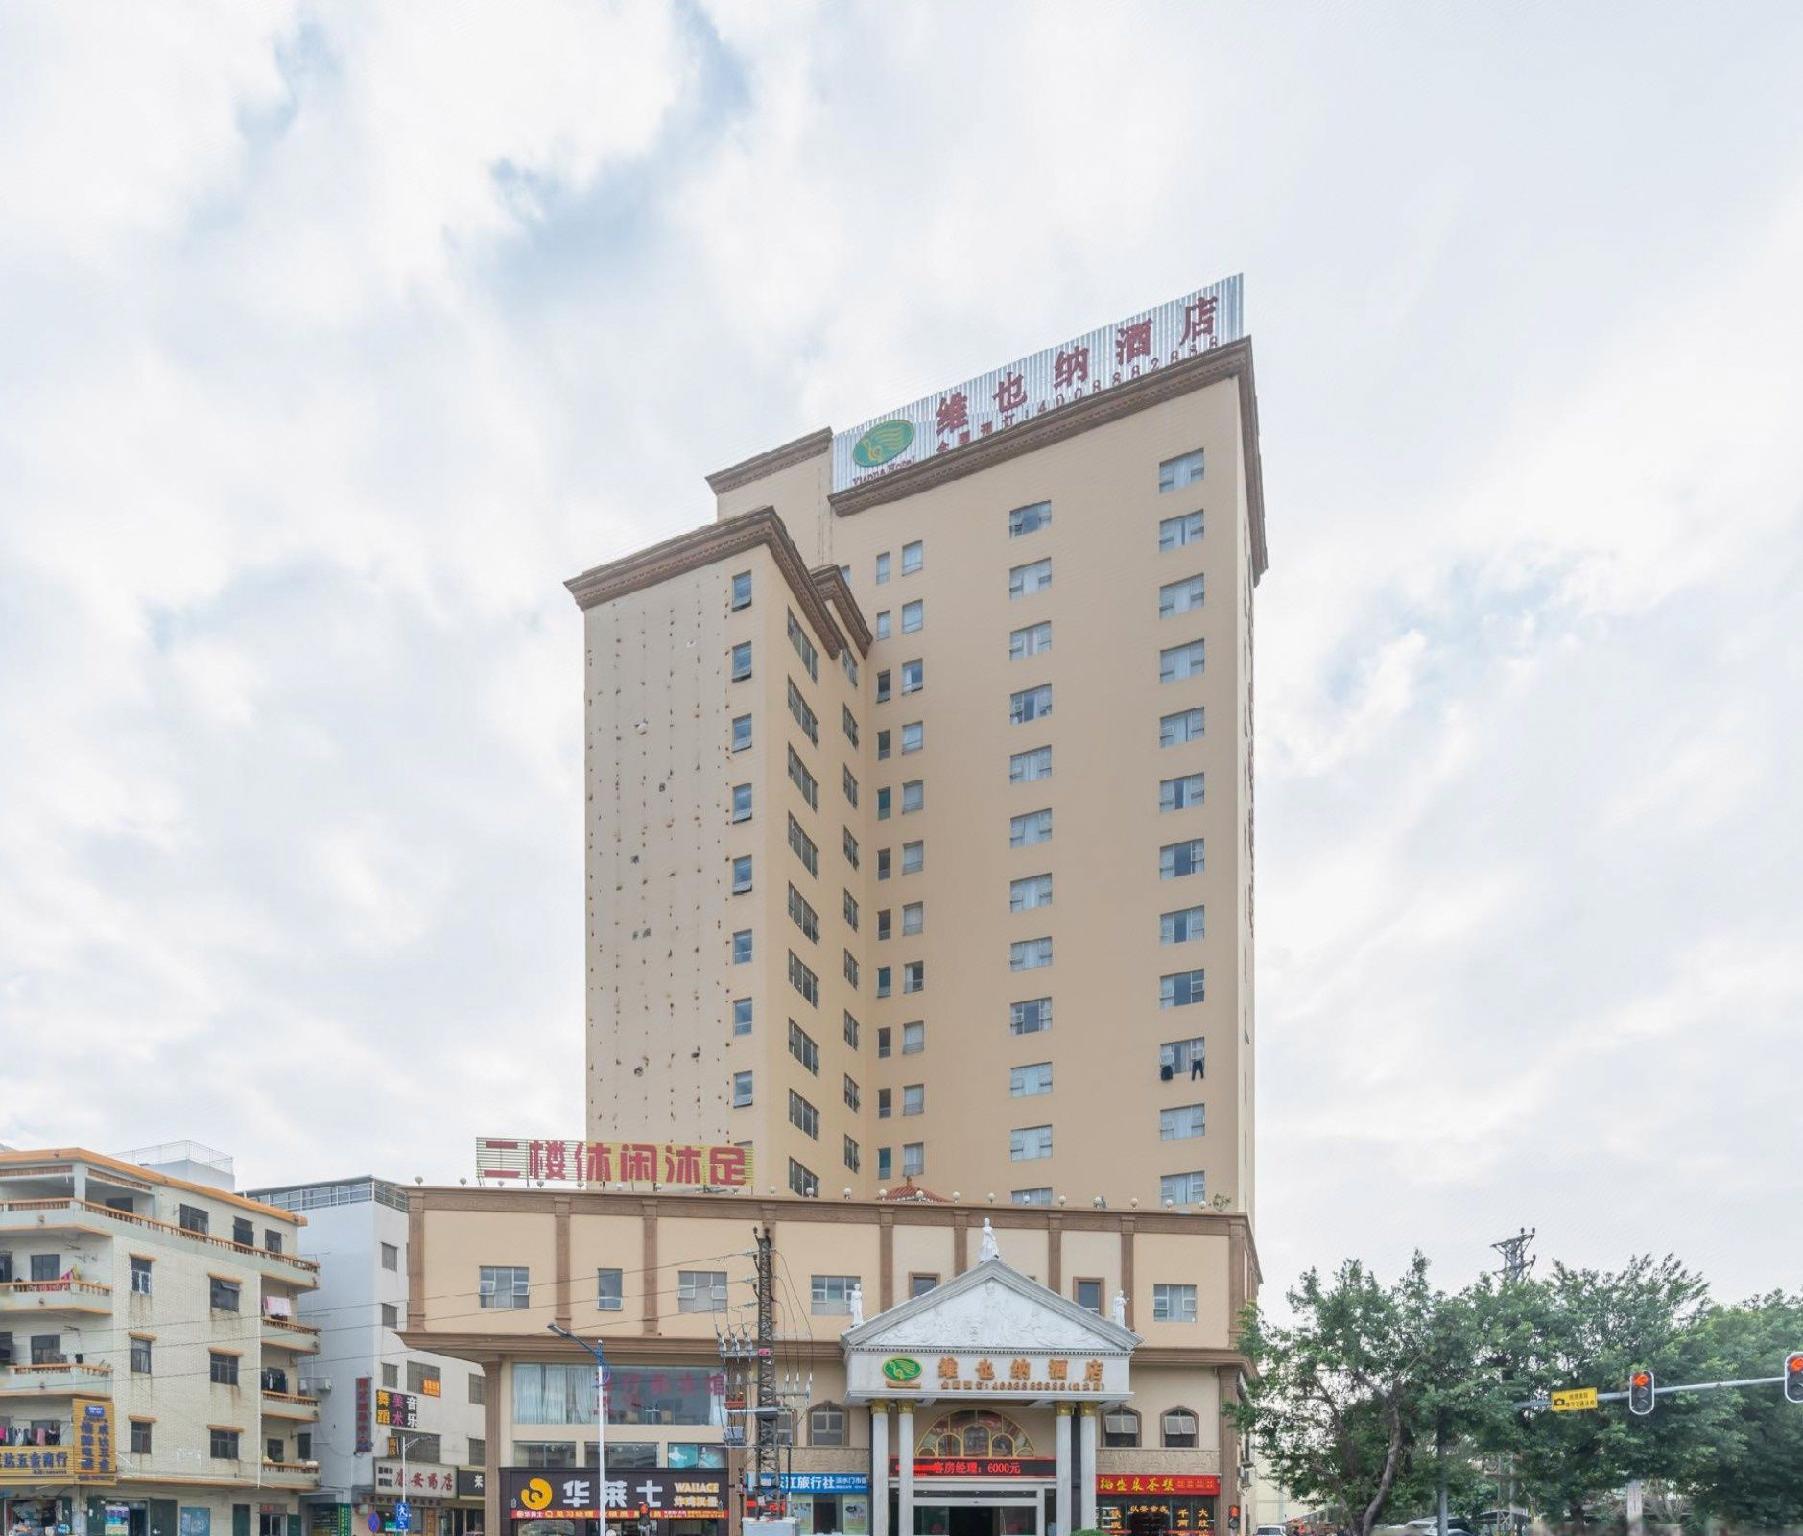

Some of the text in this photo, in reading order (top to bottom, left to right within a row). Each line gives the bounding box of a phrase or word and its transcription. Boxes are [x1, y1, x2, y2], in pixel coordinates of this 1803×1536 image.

[935, 296, 1218, 436] 维也纳酒店
[483, 1140, 745, 1186] 二楼休闲沐足
[937, 1356, 1104, 1382] 维也纳酒店
[406, 1395, 418, 1429] 音乐
[562, 1479, 663, 1508] 华莱士
